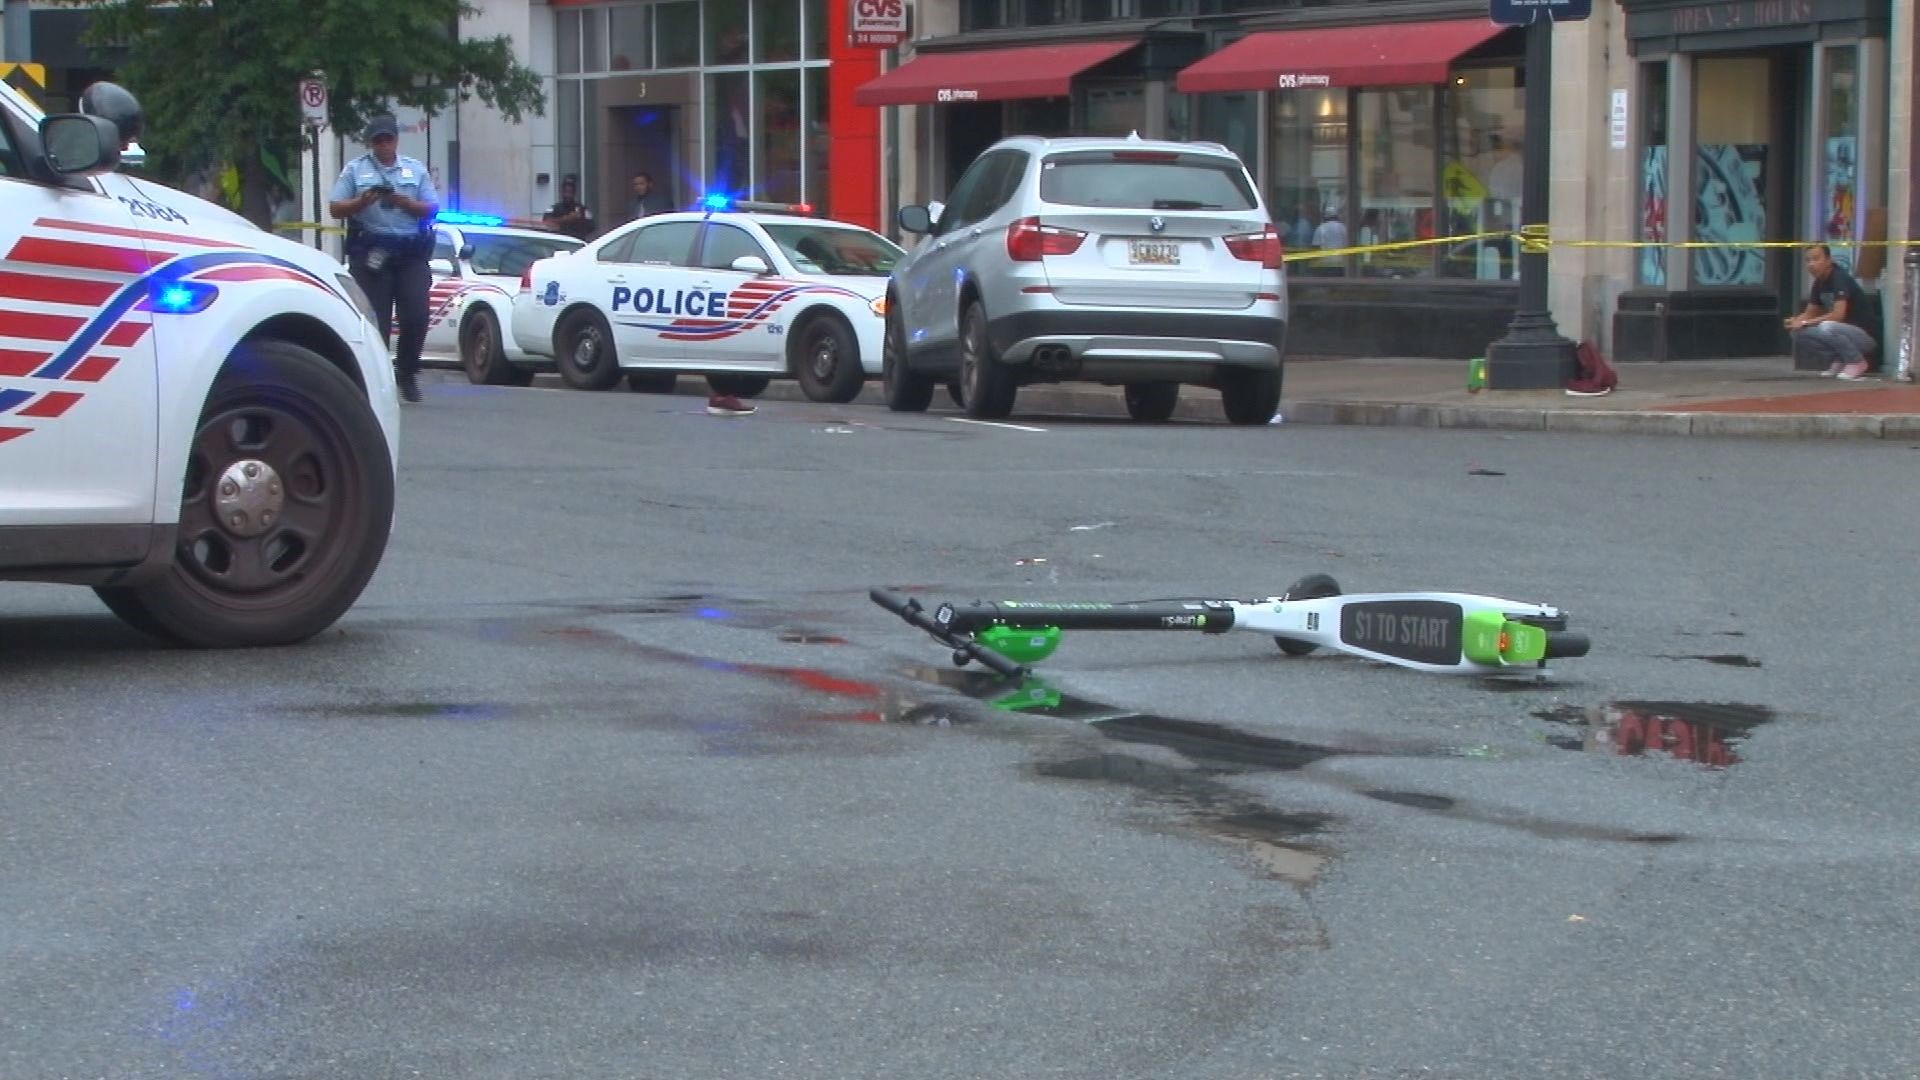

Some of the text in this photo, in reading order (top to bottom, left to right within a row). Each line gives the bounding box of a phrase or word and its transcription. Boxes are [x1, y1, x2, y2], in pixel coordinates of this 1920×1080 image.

[857, 0, 902, 17] CVS
[1673, 0, 1811, 33] OPEN 24 HOURS
[857, 19, 900, 28] pharmacy
[1279, 74, 1296, 88] CVS
[938, 88, 951, 101] CVS
[612, 286, 727, 318] POLICE
[1355, 610, 1372, 641] $1
[1376, 613, 1396, 643] TO
[1401, 615, 1450, 649] START
